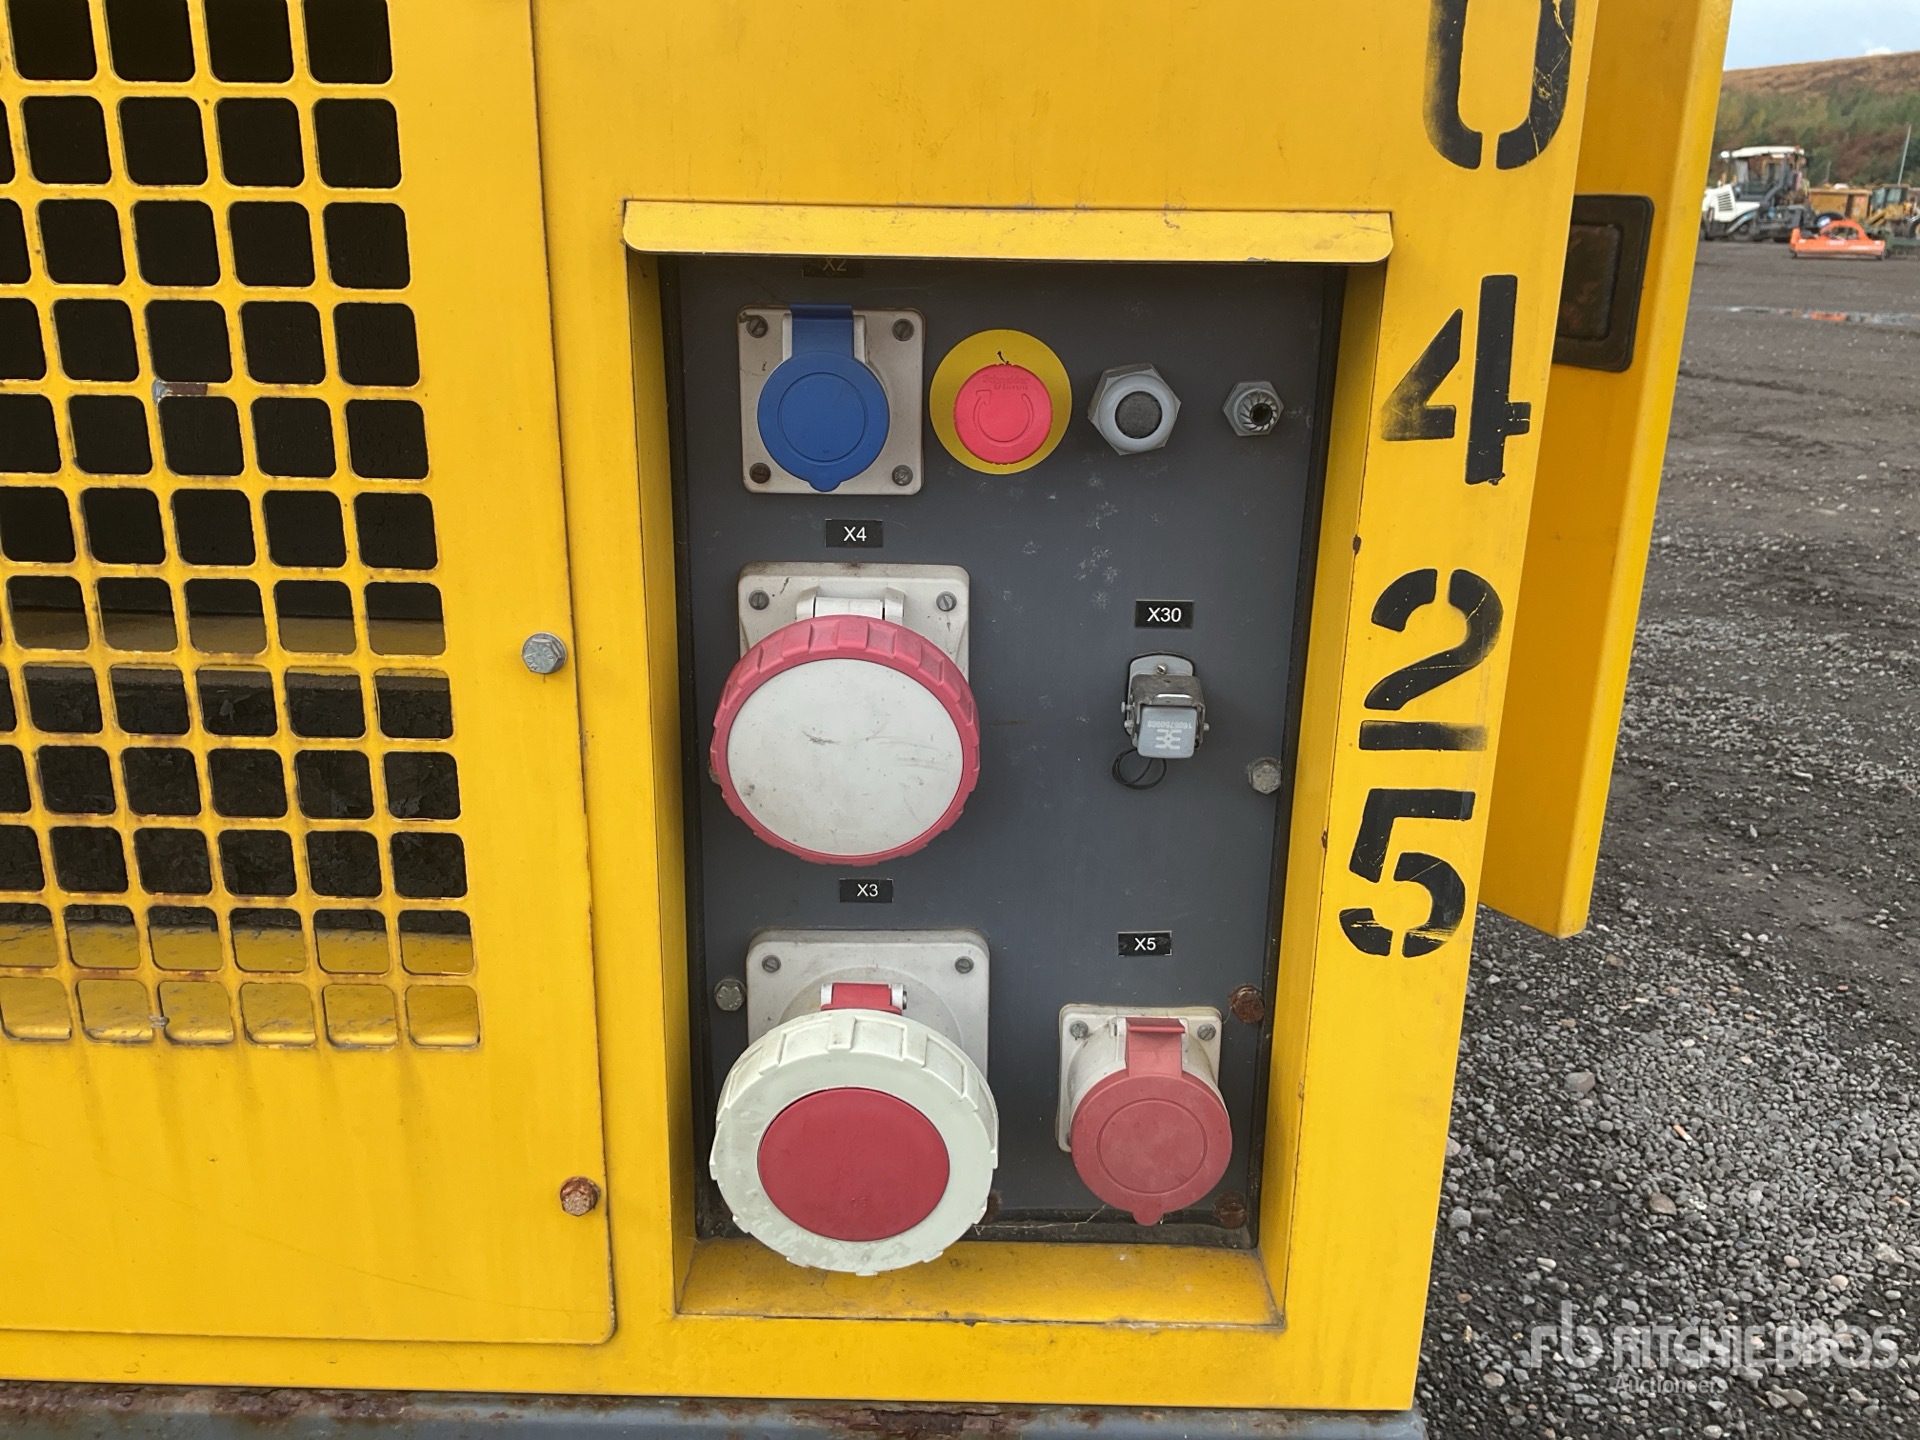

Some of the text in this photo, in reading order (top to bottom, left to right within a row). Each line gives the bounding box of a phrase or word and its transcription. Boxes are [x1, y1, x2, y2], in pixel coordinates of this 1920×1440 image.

[823, 257, 847, 271] X2
[843, 526, 867, 541] X4
[1146, 607, 1182, 622] X30
[856, 883, 879, 897] X3
[1134, 937, 1157, 951] X5
